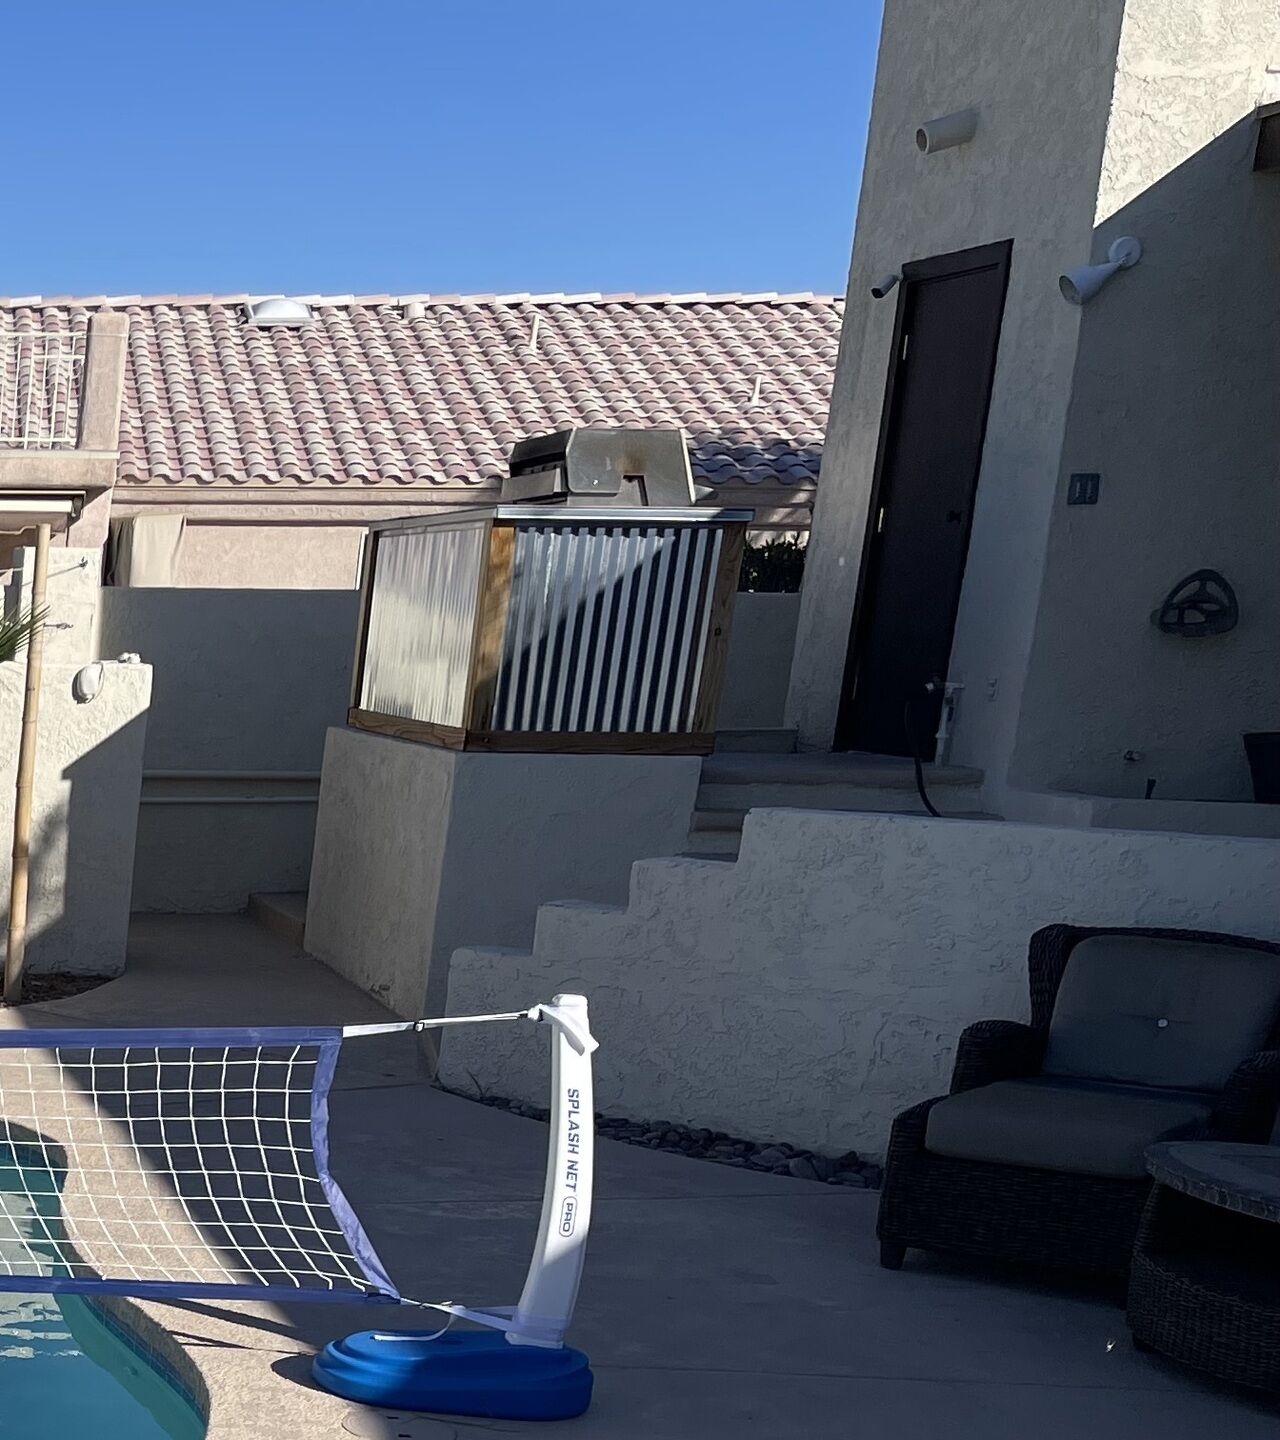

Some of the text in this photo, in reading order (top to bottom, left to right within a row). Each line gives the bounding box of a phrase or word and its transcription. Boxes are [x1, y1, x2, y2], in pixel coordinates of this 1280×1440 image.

[562, 1088, 580, 1232] SPLASH NET PRO
